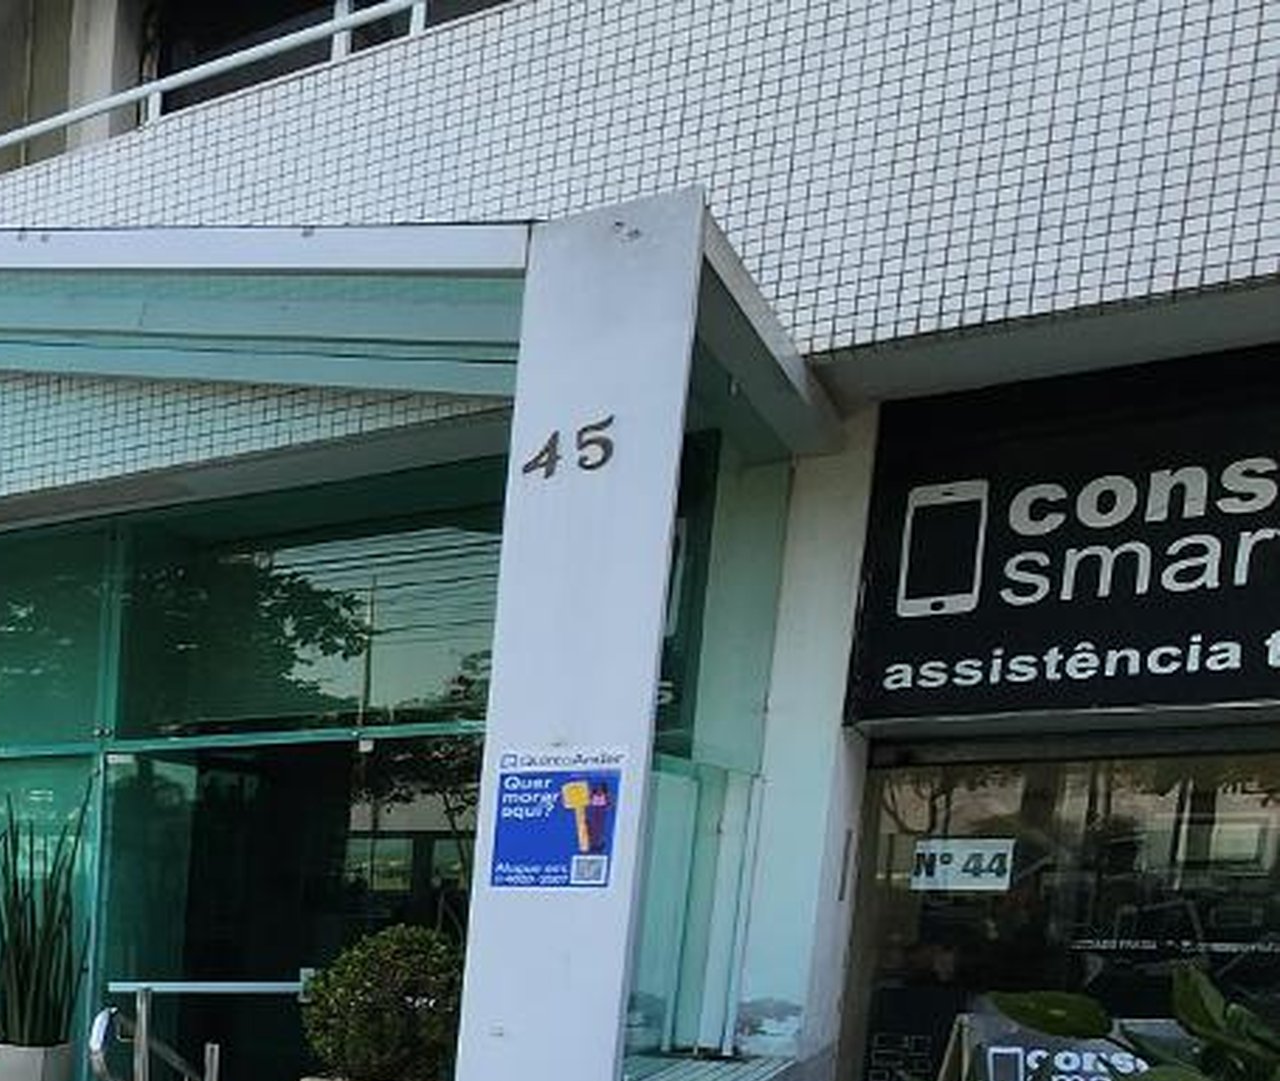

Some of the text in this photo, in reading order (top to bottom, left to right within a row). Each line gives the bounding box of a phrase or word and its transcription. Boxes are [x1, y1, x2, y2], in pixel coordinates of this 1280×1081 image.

[521, 413, 615, 479] 45
[882, 633, 1242, 690] assistência
[503, 776, 553, 791] Quer
[502, 792, 560, 804] morar
[502, 803, 554, 820] aqui?
[961, 852, 1008, 877] 44
